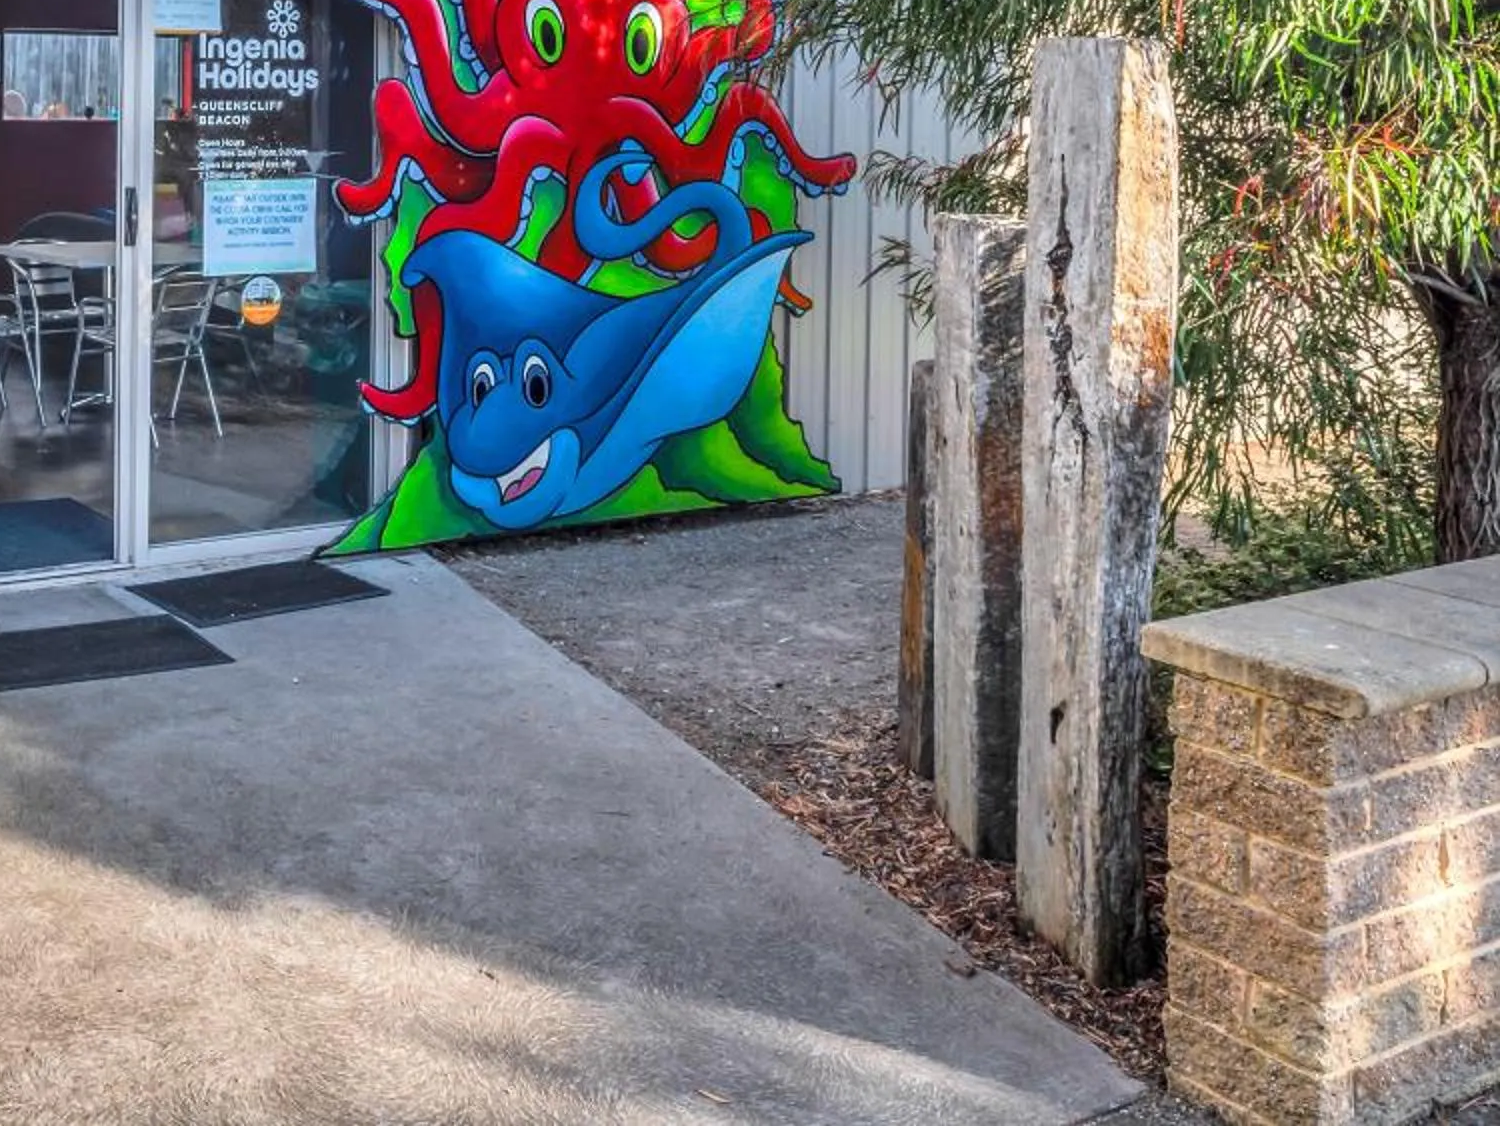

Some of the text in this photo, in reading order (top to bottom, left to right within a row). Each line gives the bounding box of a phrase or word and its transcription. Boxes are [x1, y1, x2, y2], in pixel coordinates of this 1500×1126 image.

[199, 33, 306, 67] Ingenia
[199, 62, 319, 97] Holidays
[199, 100, 284, 111] QUEENSCLIFF
[198, 115, 250, 125] BEACON
[198, 138, 245, 148] Open Hours
